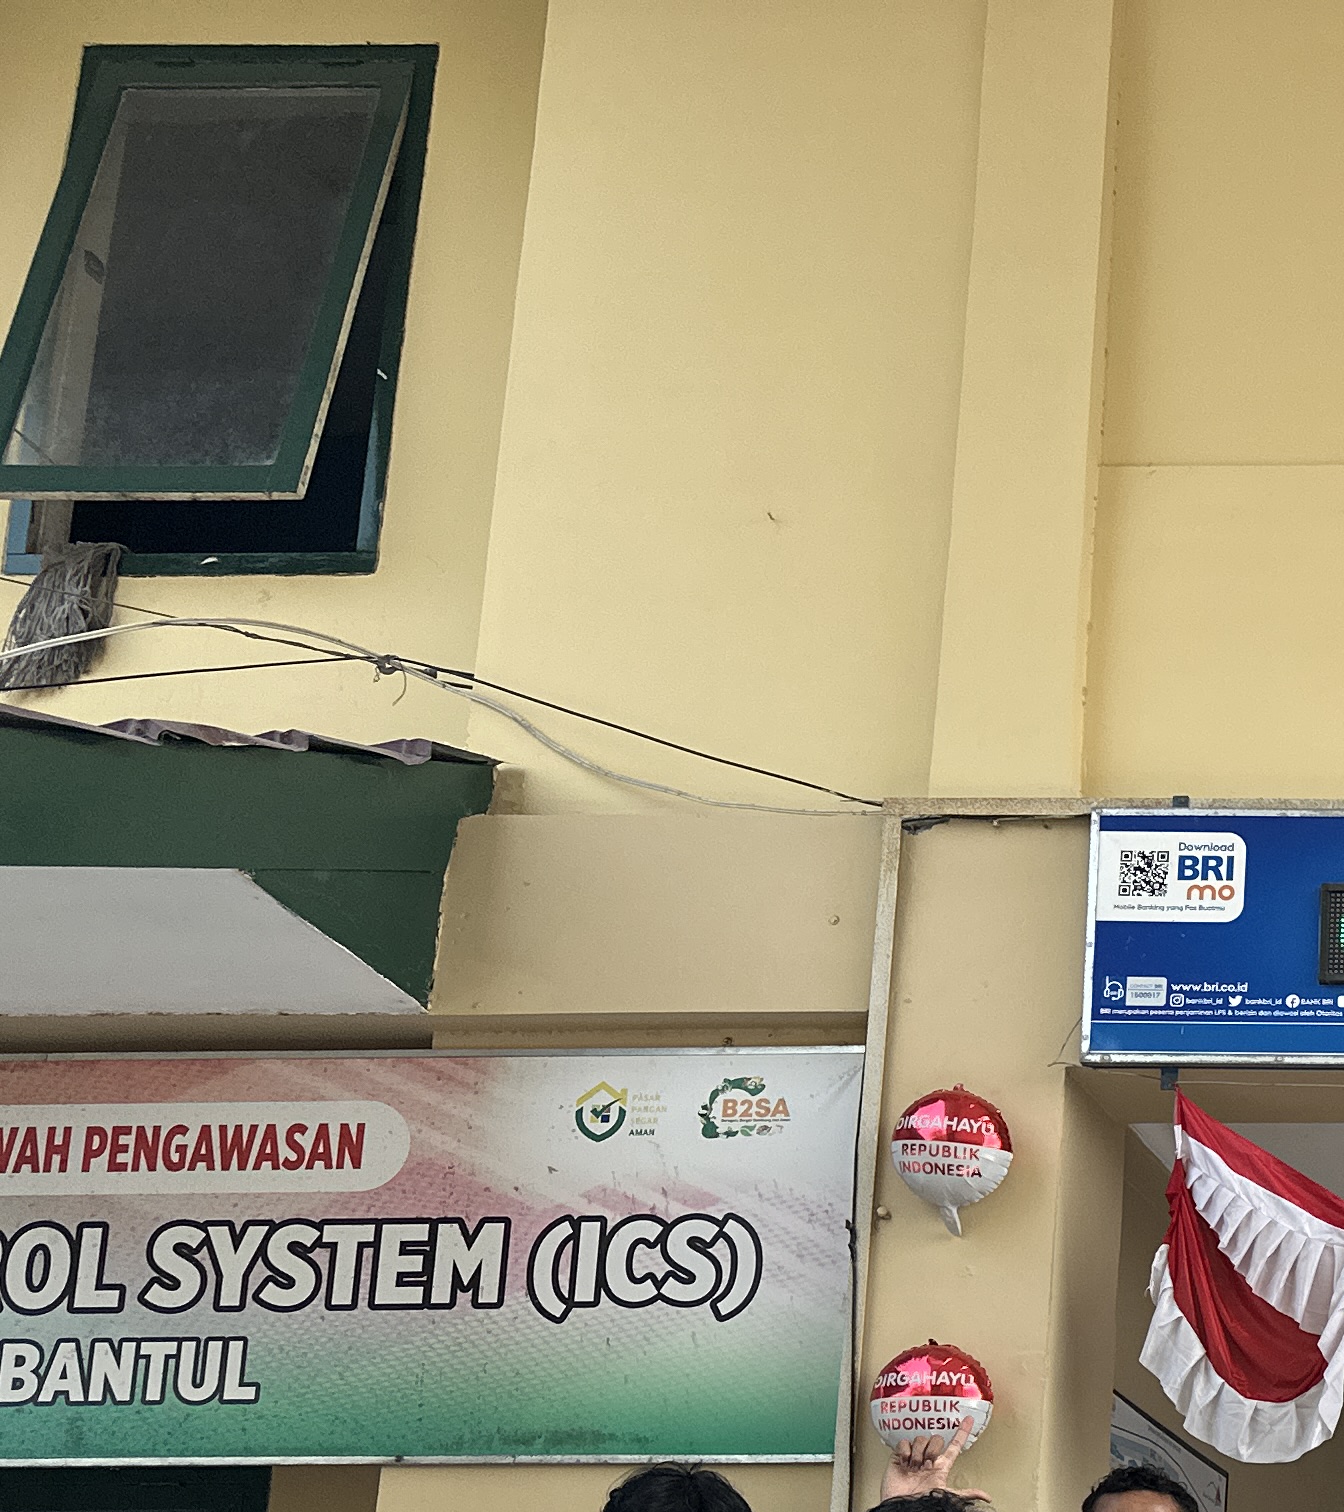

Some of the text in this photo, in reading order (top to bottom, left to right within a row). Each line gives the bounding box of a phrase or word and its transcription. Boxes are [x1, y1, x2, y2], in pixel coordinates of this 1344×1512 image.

[1178, 842, 1235, 852] Download
[1177, 855, 1235, 881] BRI
[1186, 884, 1236, 901] mo
[1170, 982, 1248, 993] www.bri.co.id
[721, 1098, 791, 1118] B2SA
[628, 1128, 656, 1137] AMAN
[896, 1113, 995, 1135] DIRGAHAYU
[82, 1123, 366, 1173] PENGAWASAN
[901, 1143, 980, 1161] REPUBLIK
[899, 1161, 982, 1179] INDONESIA
[0, 1212, 763, 1324] OL SYSTEM (ICS)
[0, 1336, 260, 1406] BANTUL
[874, 1370, 975, 1389] DIRGAHAYU
[880, 1399, 960, 1413] REPUBLIK
[878, 1417, 961, 1431] INDONESIA
